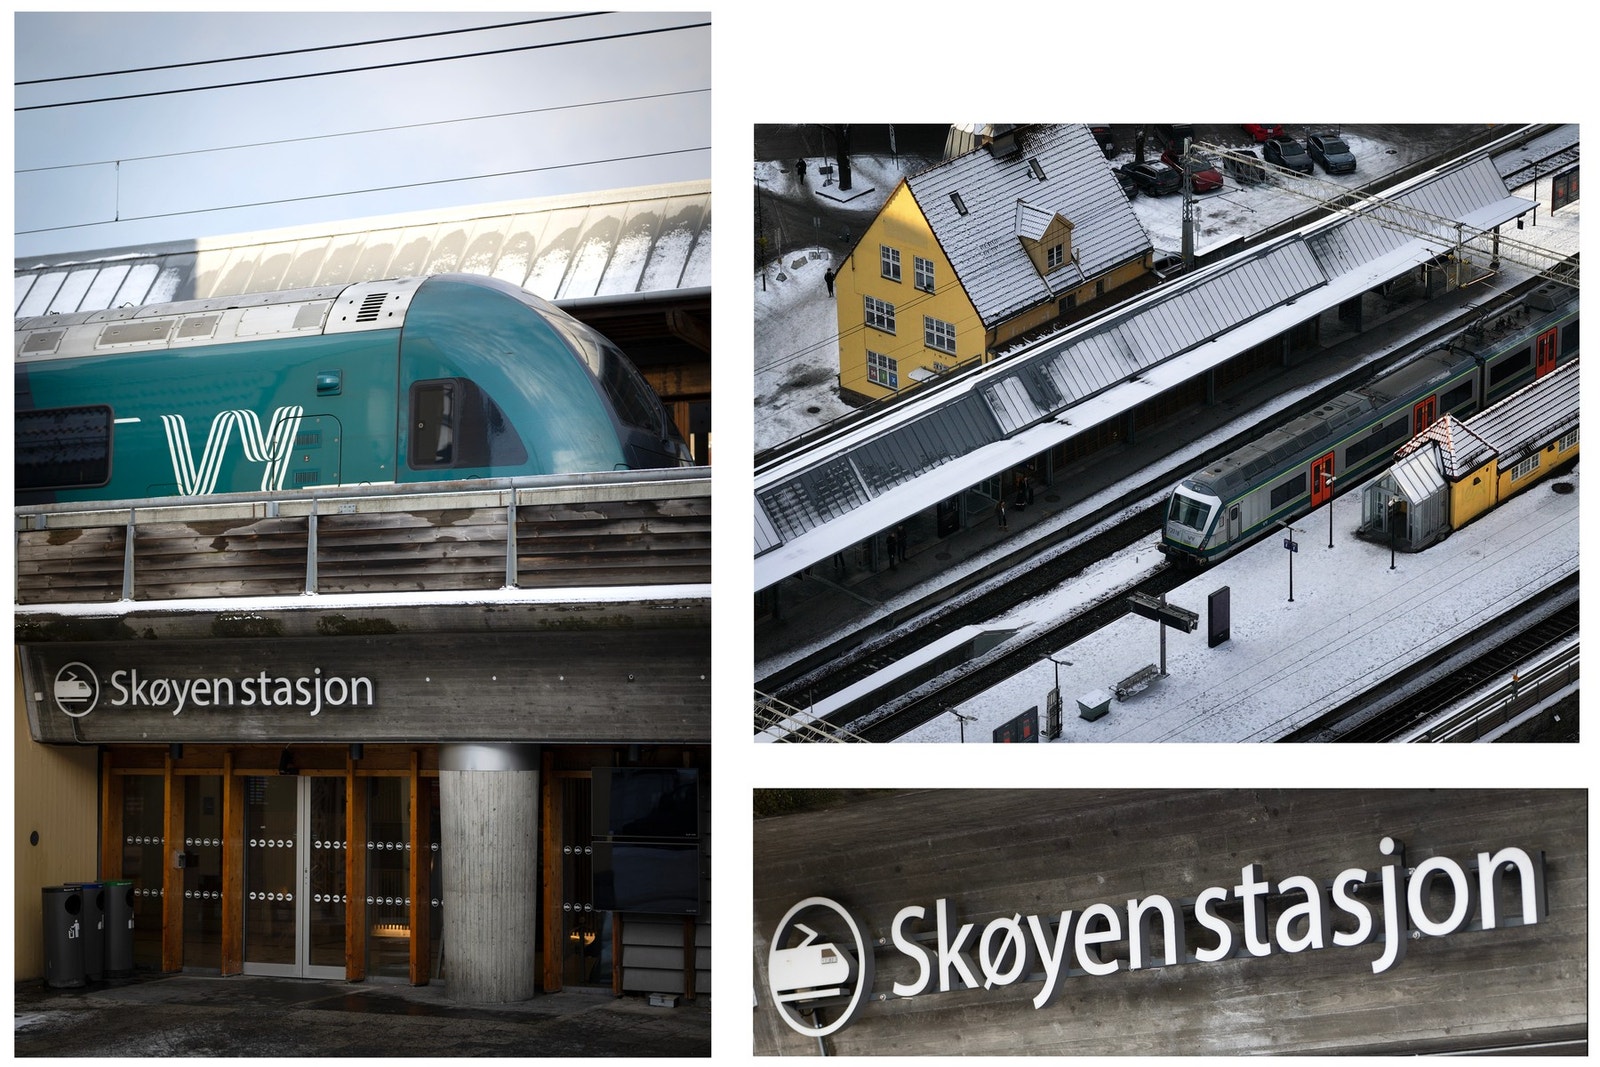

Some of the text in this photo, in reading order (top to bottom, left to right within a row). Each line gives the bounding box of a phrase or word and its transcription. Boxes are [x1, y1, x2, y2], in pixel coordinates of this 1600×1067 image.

[111, 667, 373, 716] Skøyen stasjon
[891, 836, 1539, 1010] Skøyen stasjon
